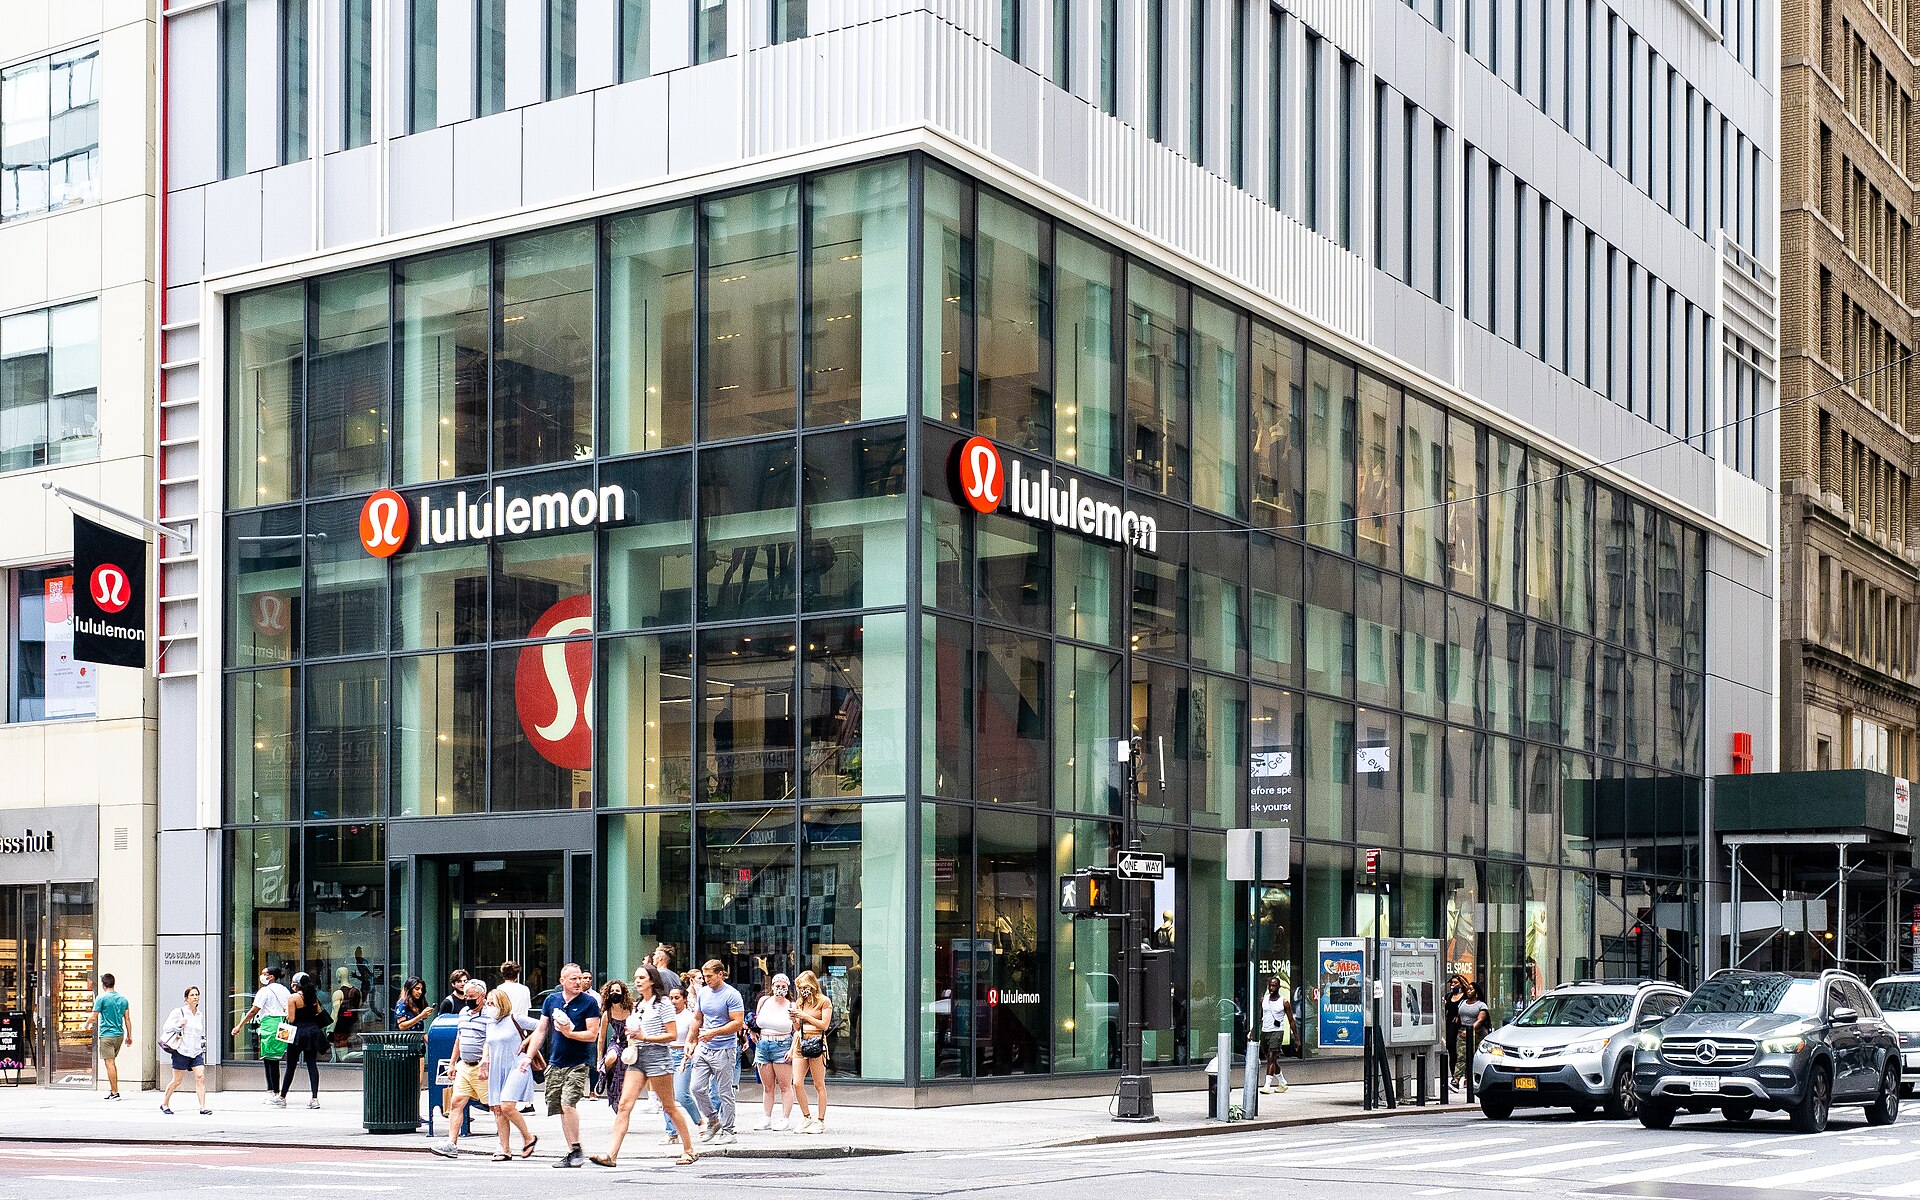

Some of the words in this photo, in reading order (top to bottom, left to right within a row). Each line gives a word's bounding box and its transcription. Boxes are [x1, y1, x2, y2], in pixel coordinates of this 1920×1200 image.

[1011, 459, 1157, 553] lululemon
[420, 484, 625, 545] lululemon
[75, 615, 145, 642] lululemon
[24, 828, 51, 853] hut
[1123, 860, 1138, 871] ONE
[1145, 861, 1160, 872] WAY
[1337, 961, 1361, 972] MEGA
[1454, 962, 1473, 974] SPACE
[1000, 989, 1040, 1004] lululemon
[1323, 1003, 1362, 1013] MILLION
